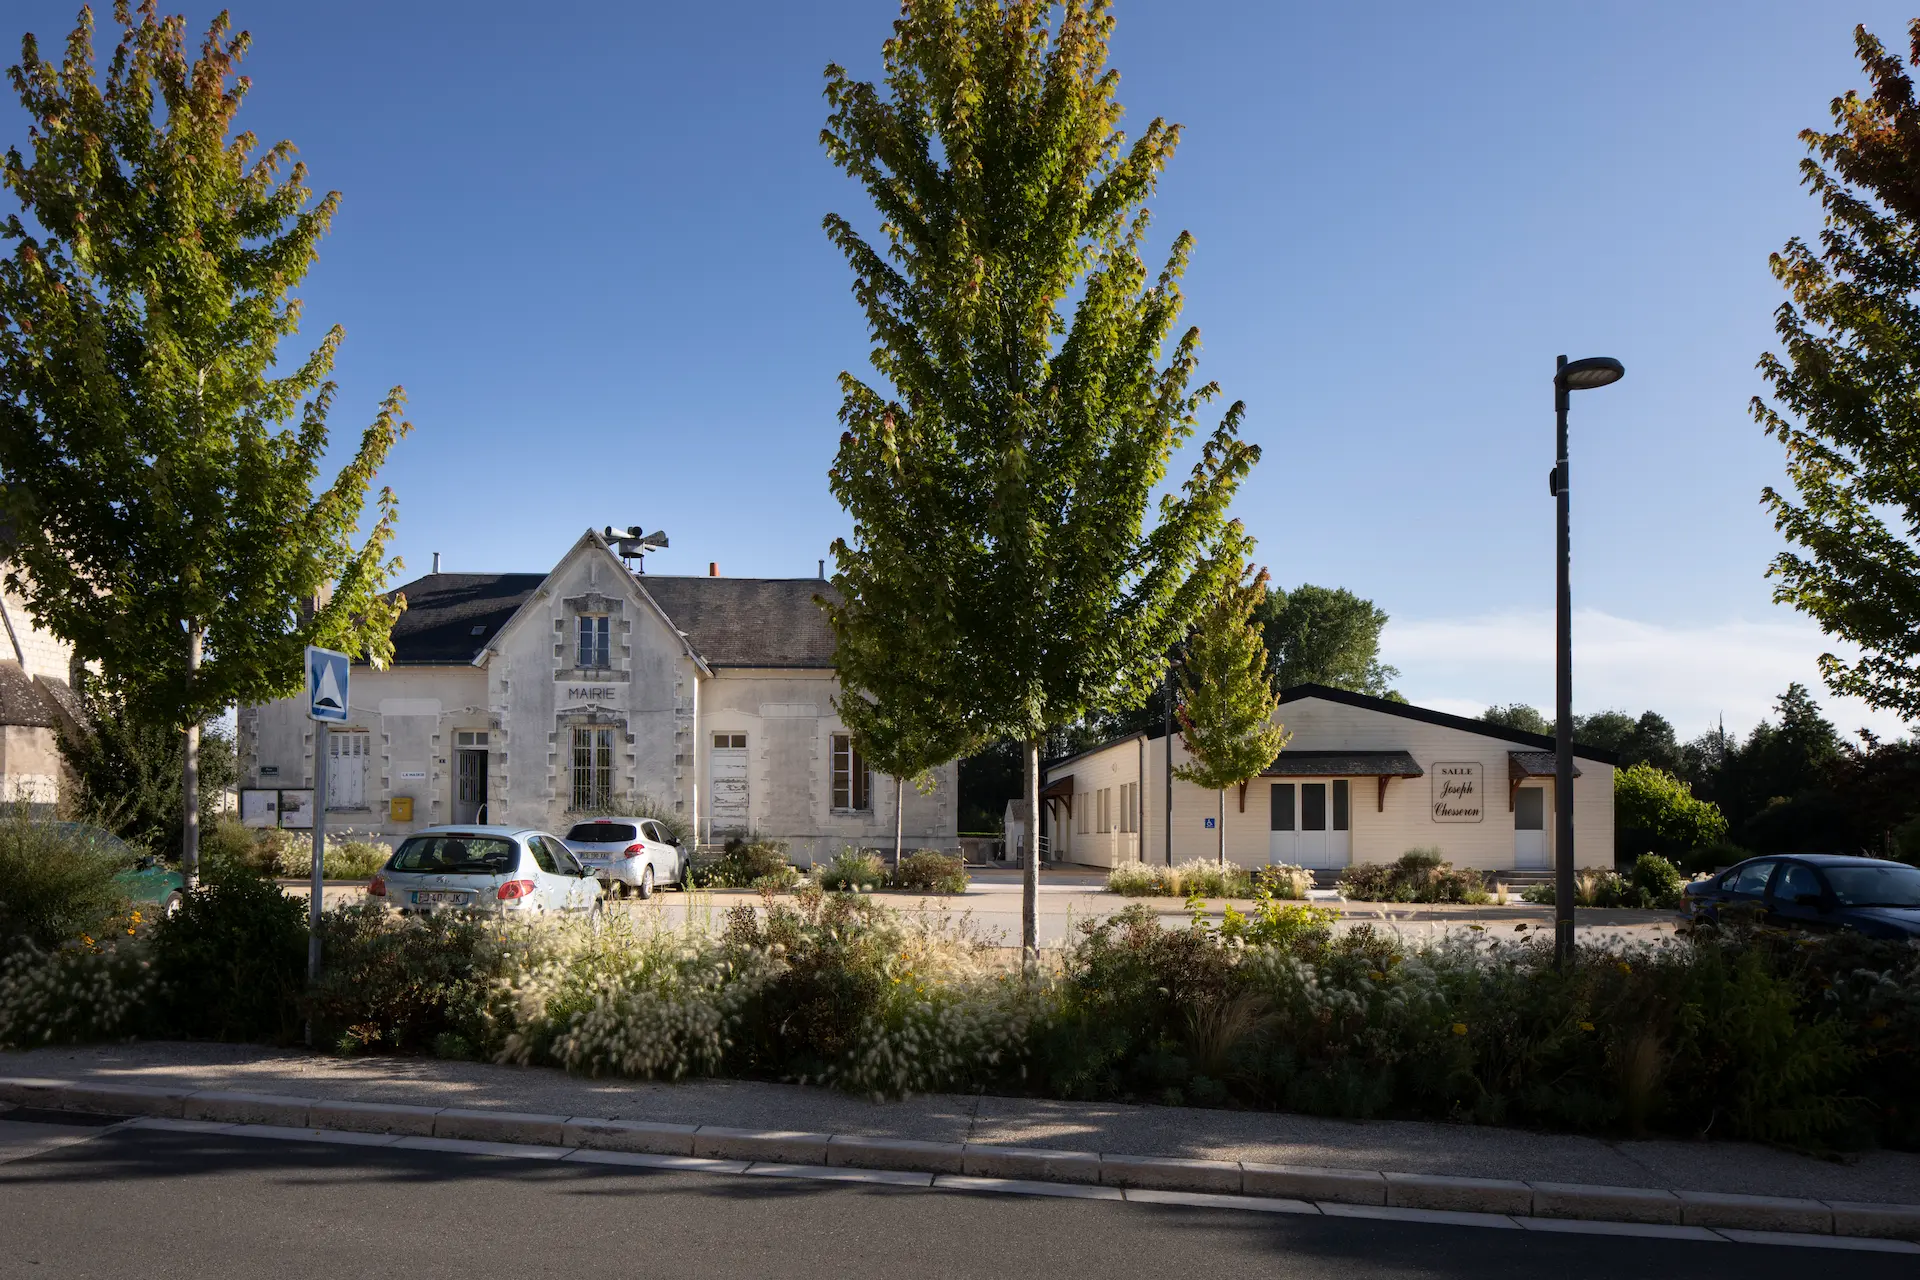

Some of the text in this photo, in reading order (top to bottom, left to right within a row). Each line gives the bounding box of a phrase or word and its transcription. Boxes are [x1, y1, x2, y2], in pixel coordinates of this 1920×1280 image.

[568, 687, 616, 700] MAIRIE
[1440, 780, 1473, 799] Joseph
[1434, 802, 1479, 817] Chesseron
